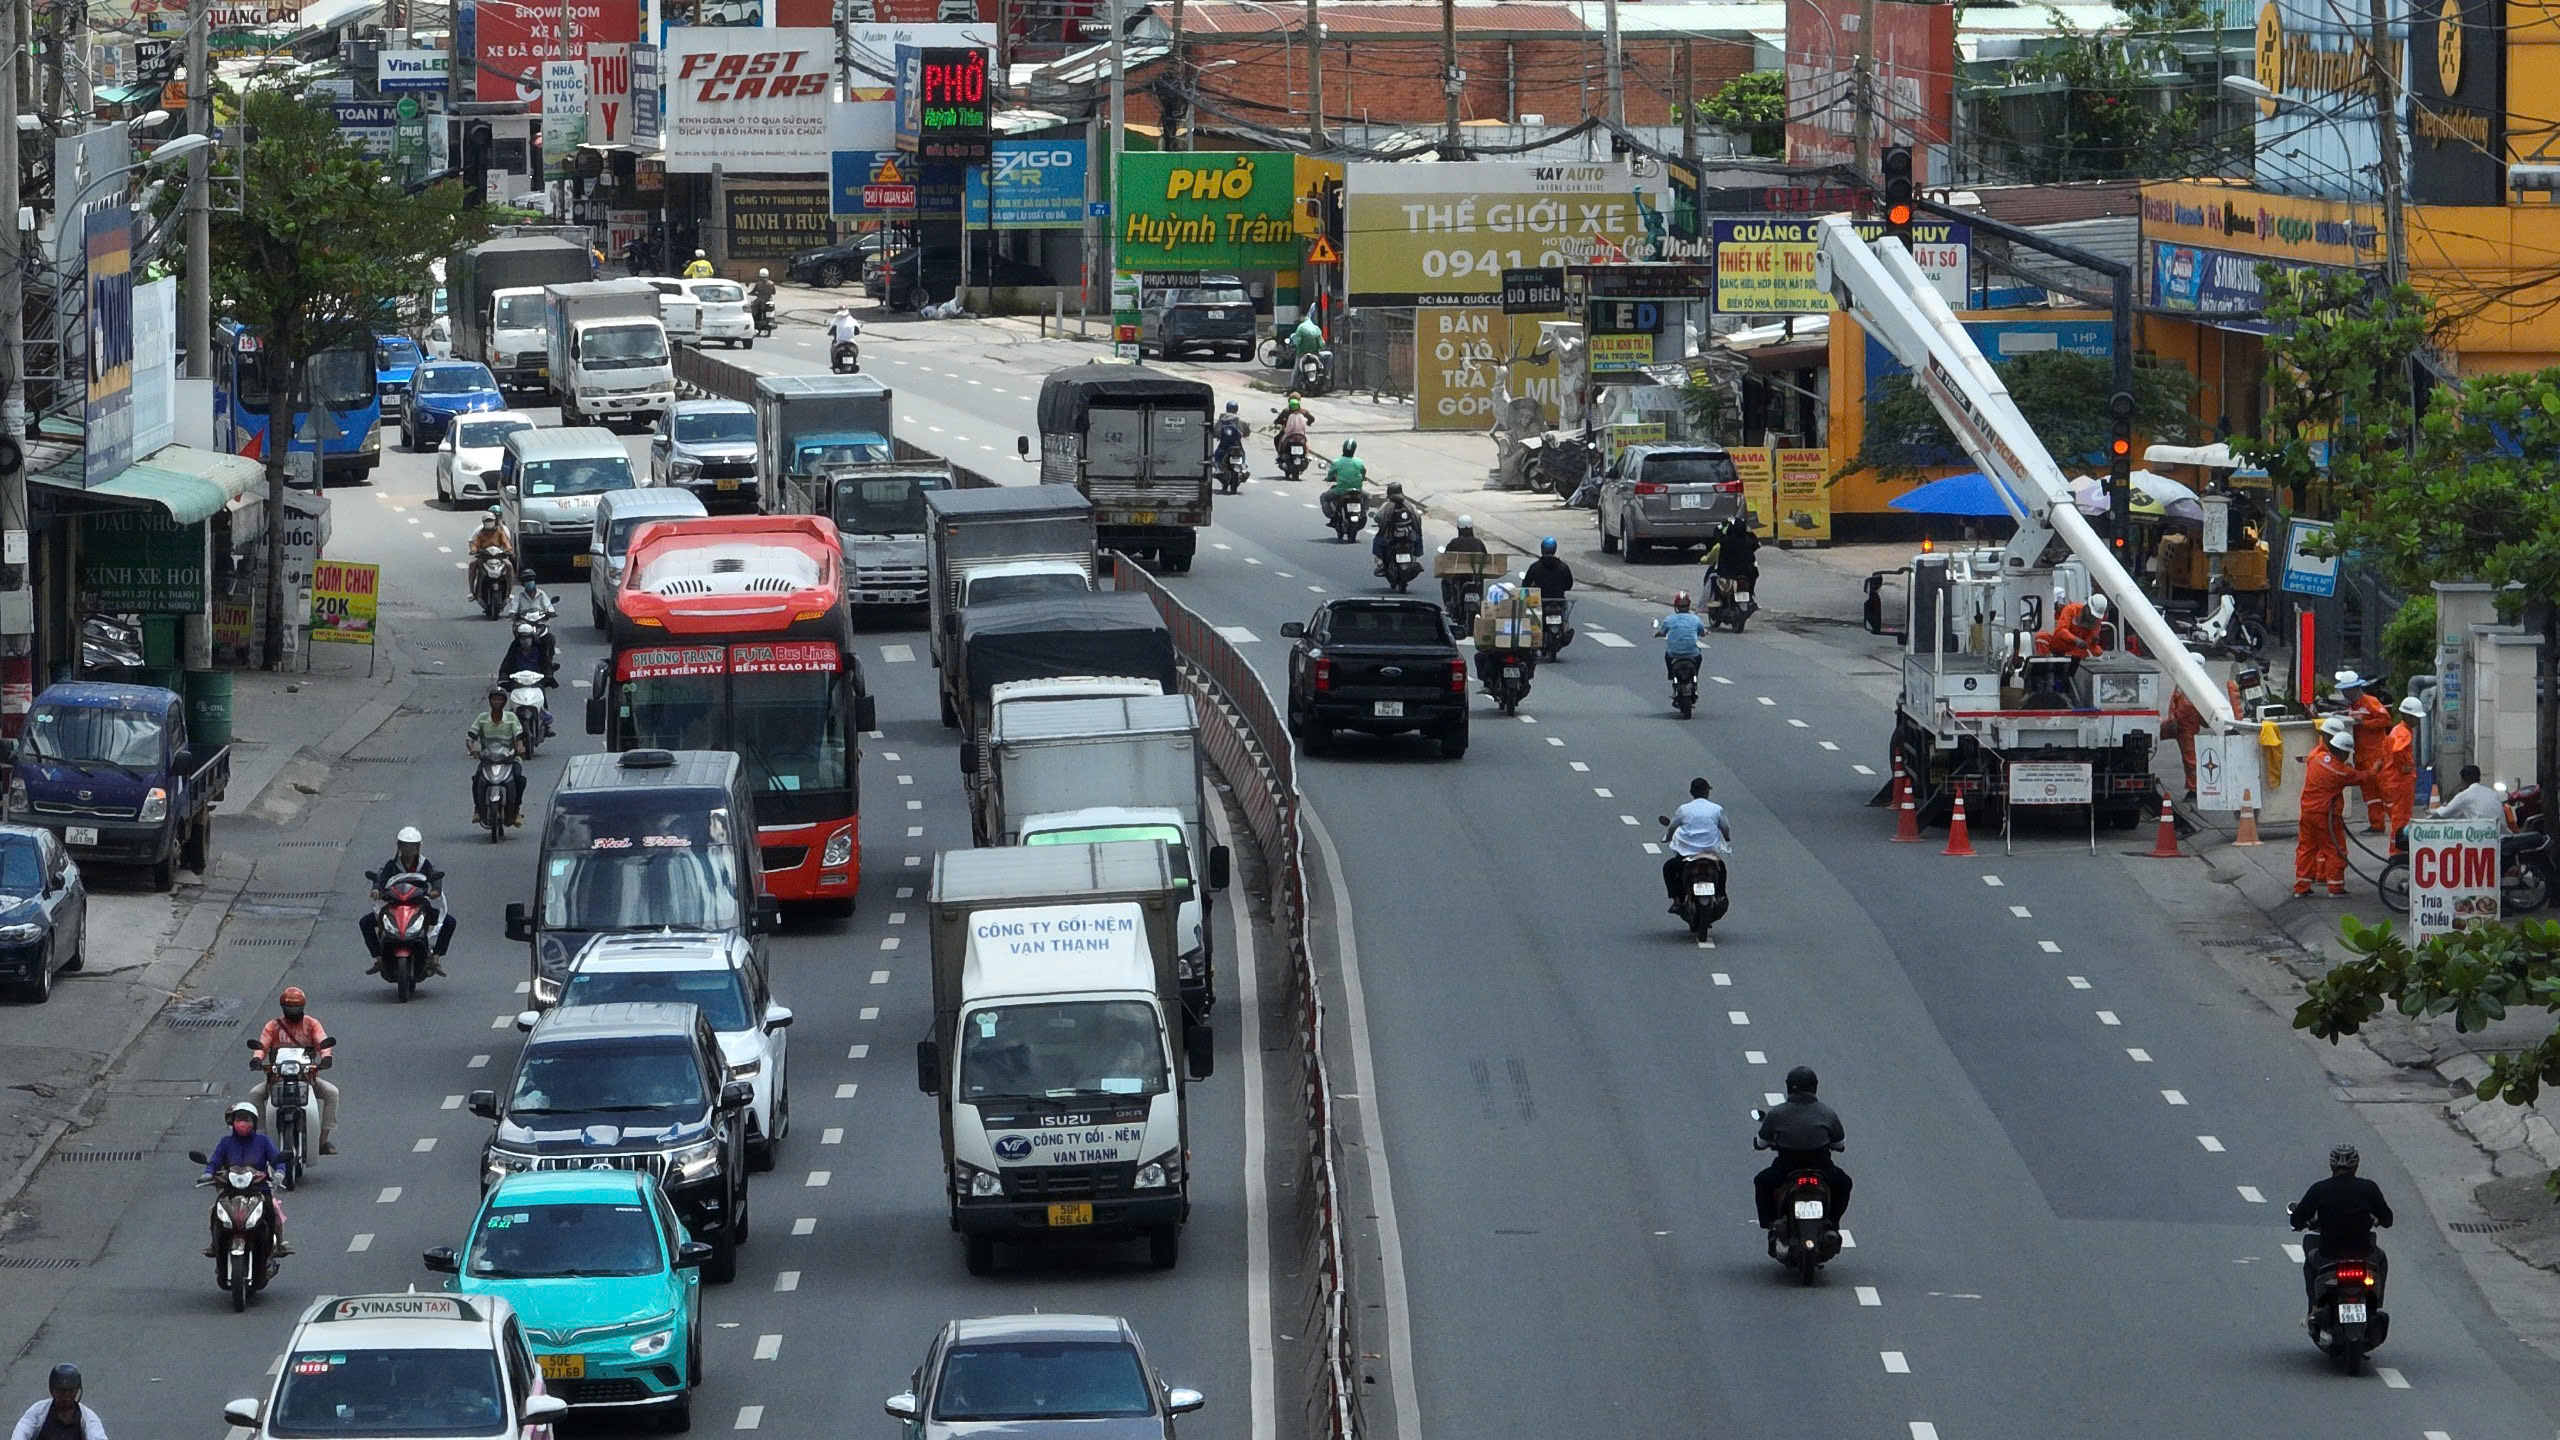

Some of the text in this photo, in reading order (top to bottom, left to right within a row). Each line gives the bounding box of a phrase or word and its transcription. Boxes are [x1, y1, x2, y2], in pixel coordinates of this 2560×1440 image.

[591, 48, 628, 95] THÚ
[679, 51, 809, 79] FAST
[697, 72, 829, 102] CARS
[925, 50, 984, 103] PHỞ
[601, 102, 619, 141] Y
[1167, 157, 1254, 199] PHỞ
[1535, 168, 1604, 180] KAY AUTO
[735, 213, 779, 231] MINH
[1402, 196, 1625, 233] THẾ GIỚI XE
[1126, 212, 1293, 251] Huỳnh Trâm
[1733, 219, 1802, 242] QUẢNG
[1720, 244, 1752, 272] THIẾT
[1756, 244, 1772, 272] KẾ
[1784, 251, 1803, 272] THI
[1439, 311, 1489, 333] BÁN
[2080, 332, 2097, 342] HP
[1437, 391, 1491, 416] GÓP
[137, 567, 161, 585] XE
[316, 564, 376, 594] CƠM CHAY
[316, 596, 349, 616] 20K
[632, 645, 836, 667] PHƯƠNG TRANG FUTA Bus Lines
[653, 668, 668, 677] XE
[761, 663, 776, 672] XE
[780, 663, 802, 672] CAO
[2442, 826, 2463, 840] Kim
[2415, 843, 2496, 889] CƠM
[978, 914, 1133, 938] CÔNG TY GỐI-NỆM
[1010, 938, 1110, 956] VẠN THẠNH
[1040, 1114, 1091, 1126] ISUZU
[1033, 1131, 1064, 1147] CÔNG
[1067, 1132, 1082, 1144] TY
[1085, 1126, 1104, 1144] GỐI
[1115, 1127, 1141, 1144] NỆM
[1053, 1147, 1118, 1166] VẠN THẠNH
[1054, 1214, 1089, 1225] 156.44
[1060, 1204, 1080, 1215] 50H
[361, 1301, 451, 1313] VINASUN TAXI
[549, 1356, 572, 1366] 50E
